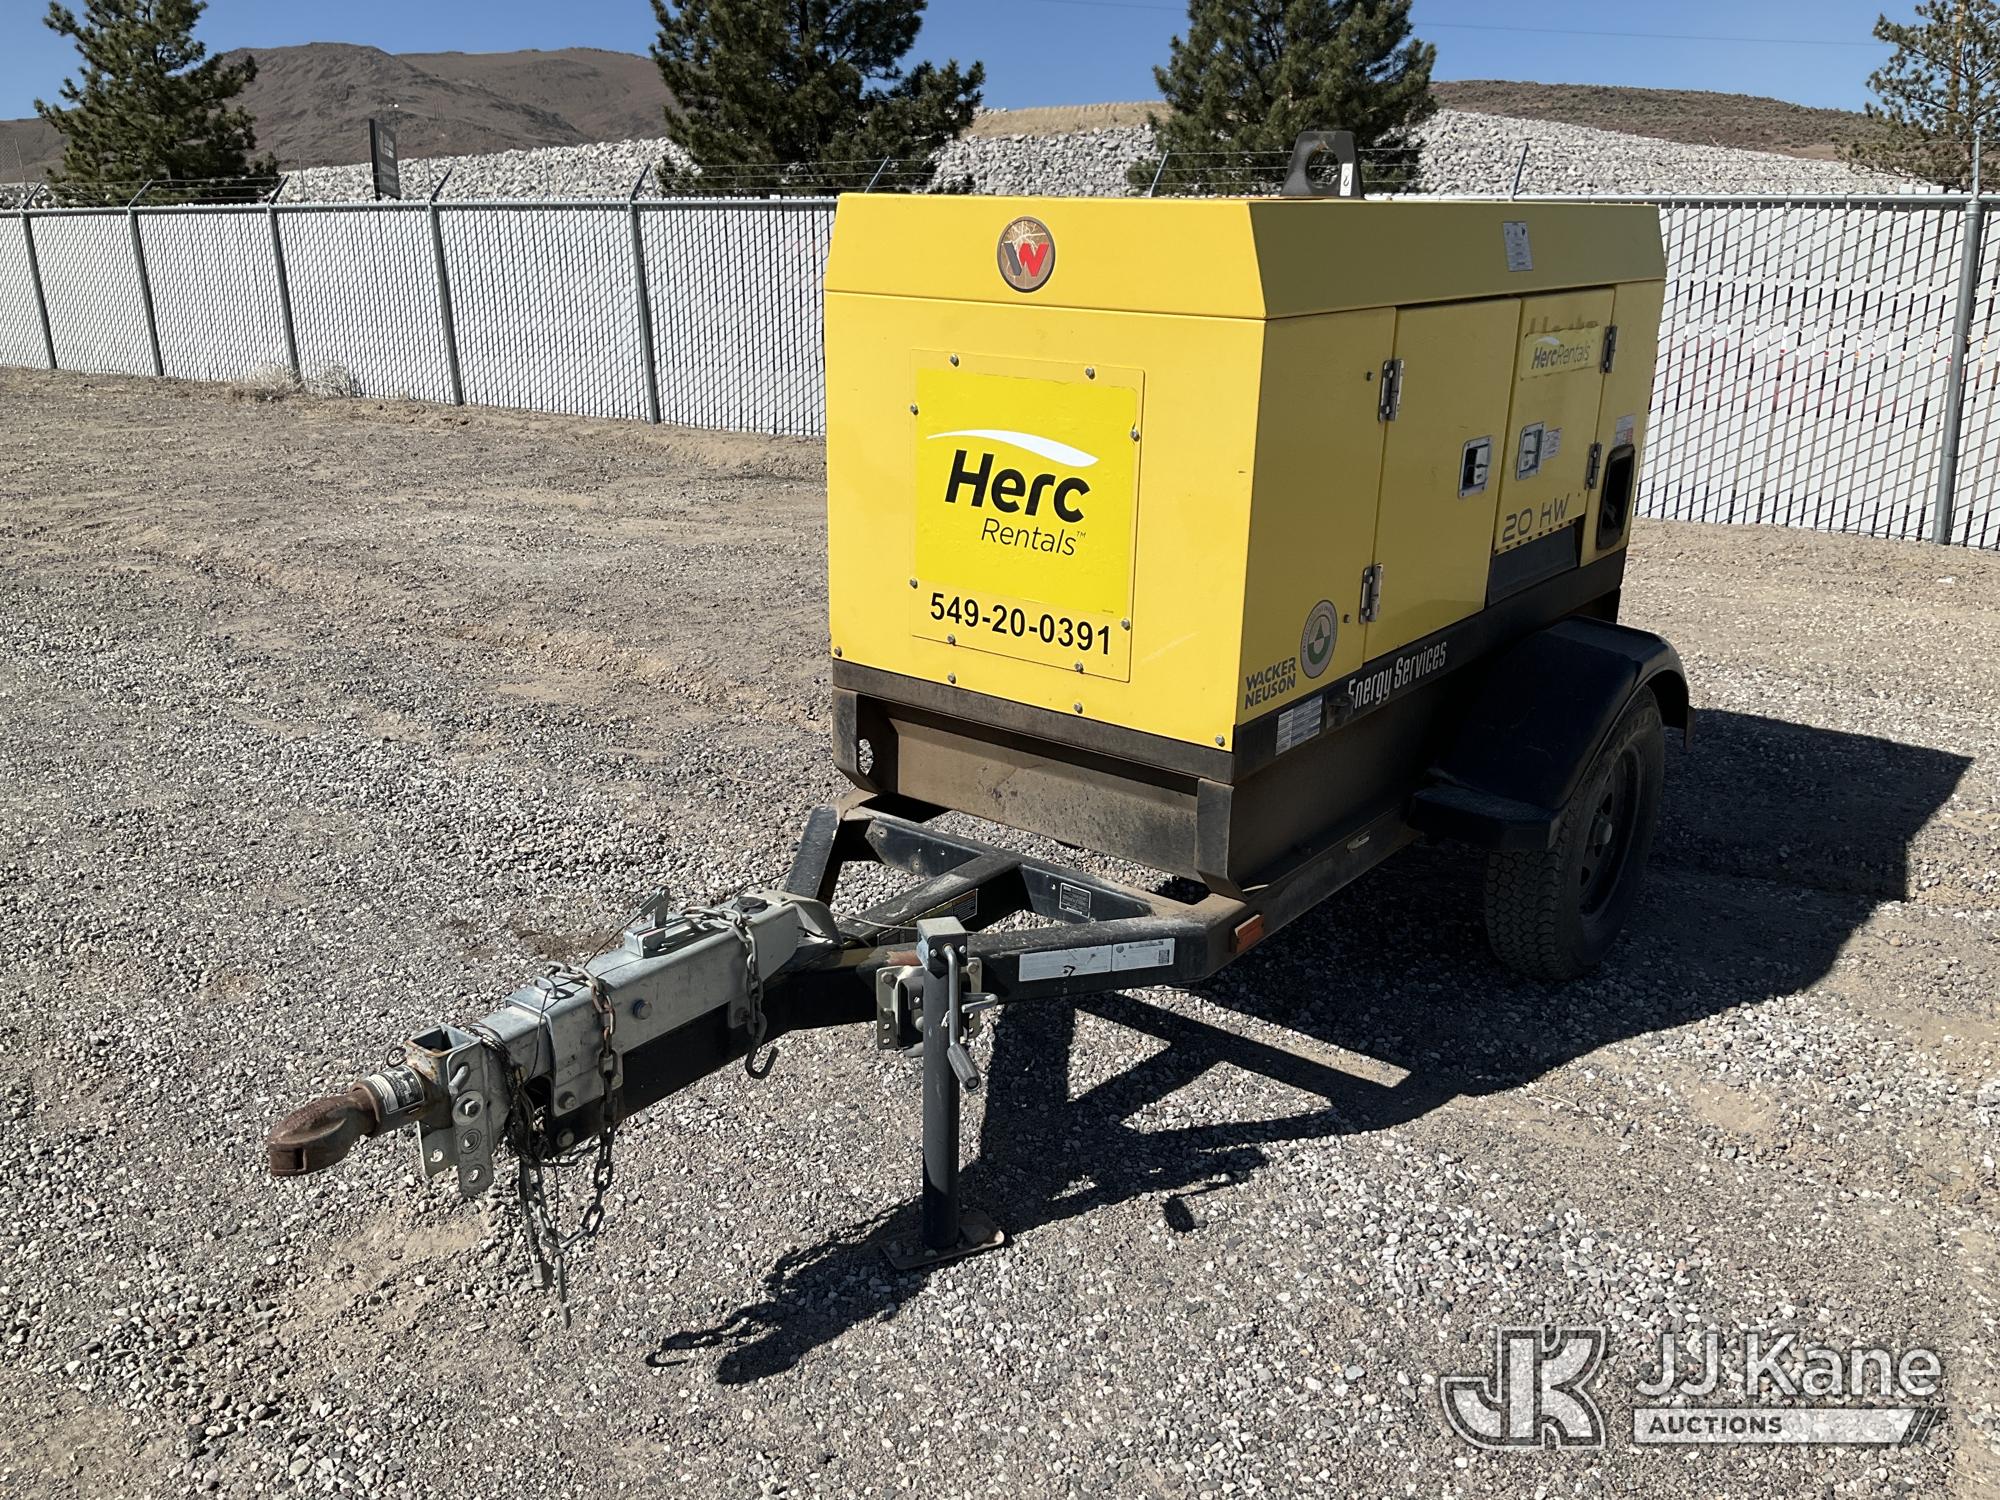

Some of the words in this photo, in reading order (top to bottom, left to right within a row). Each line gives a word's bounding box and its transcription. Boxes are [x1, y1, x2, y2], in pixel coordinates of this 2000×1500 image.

[945, 449, 1090, 523] Herc
[1502, 507, 1533, 543] 20
[930, 592, 1110, 655] 549-20-0391
[1245, 656, 1296, 691] WACKER
[1394, 641, 1447, 689] Services
[1244, 673, 1296, 710] NEUSON
